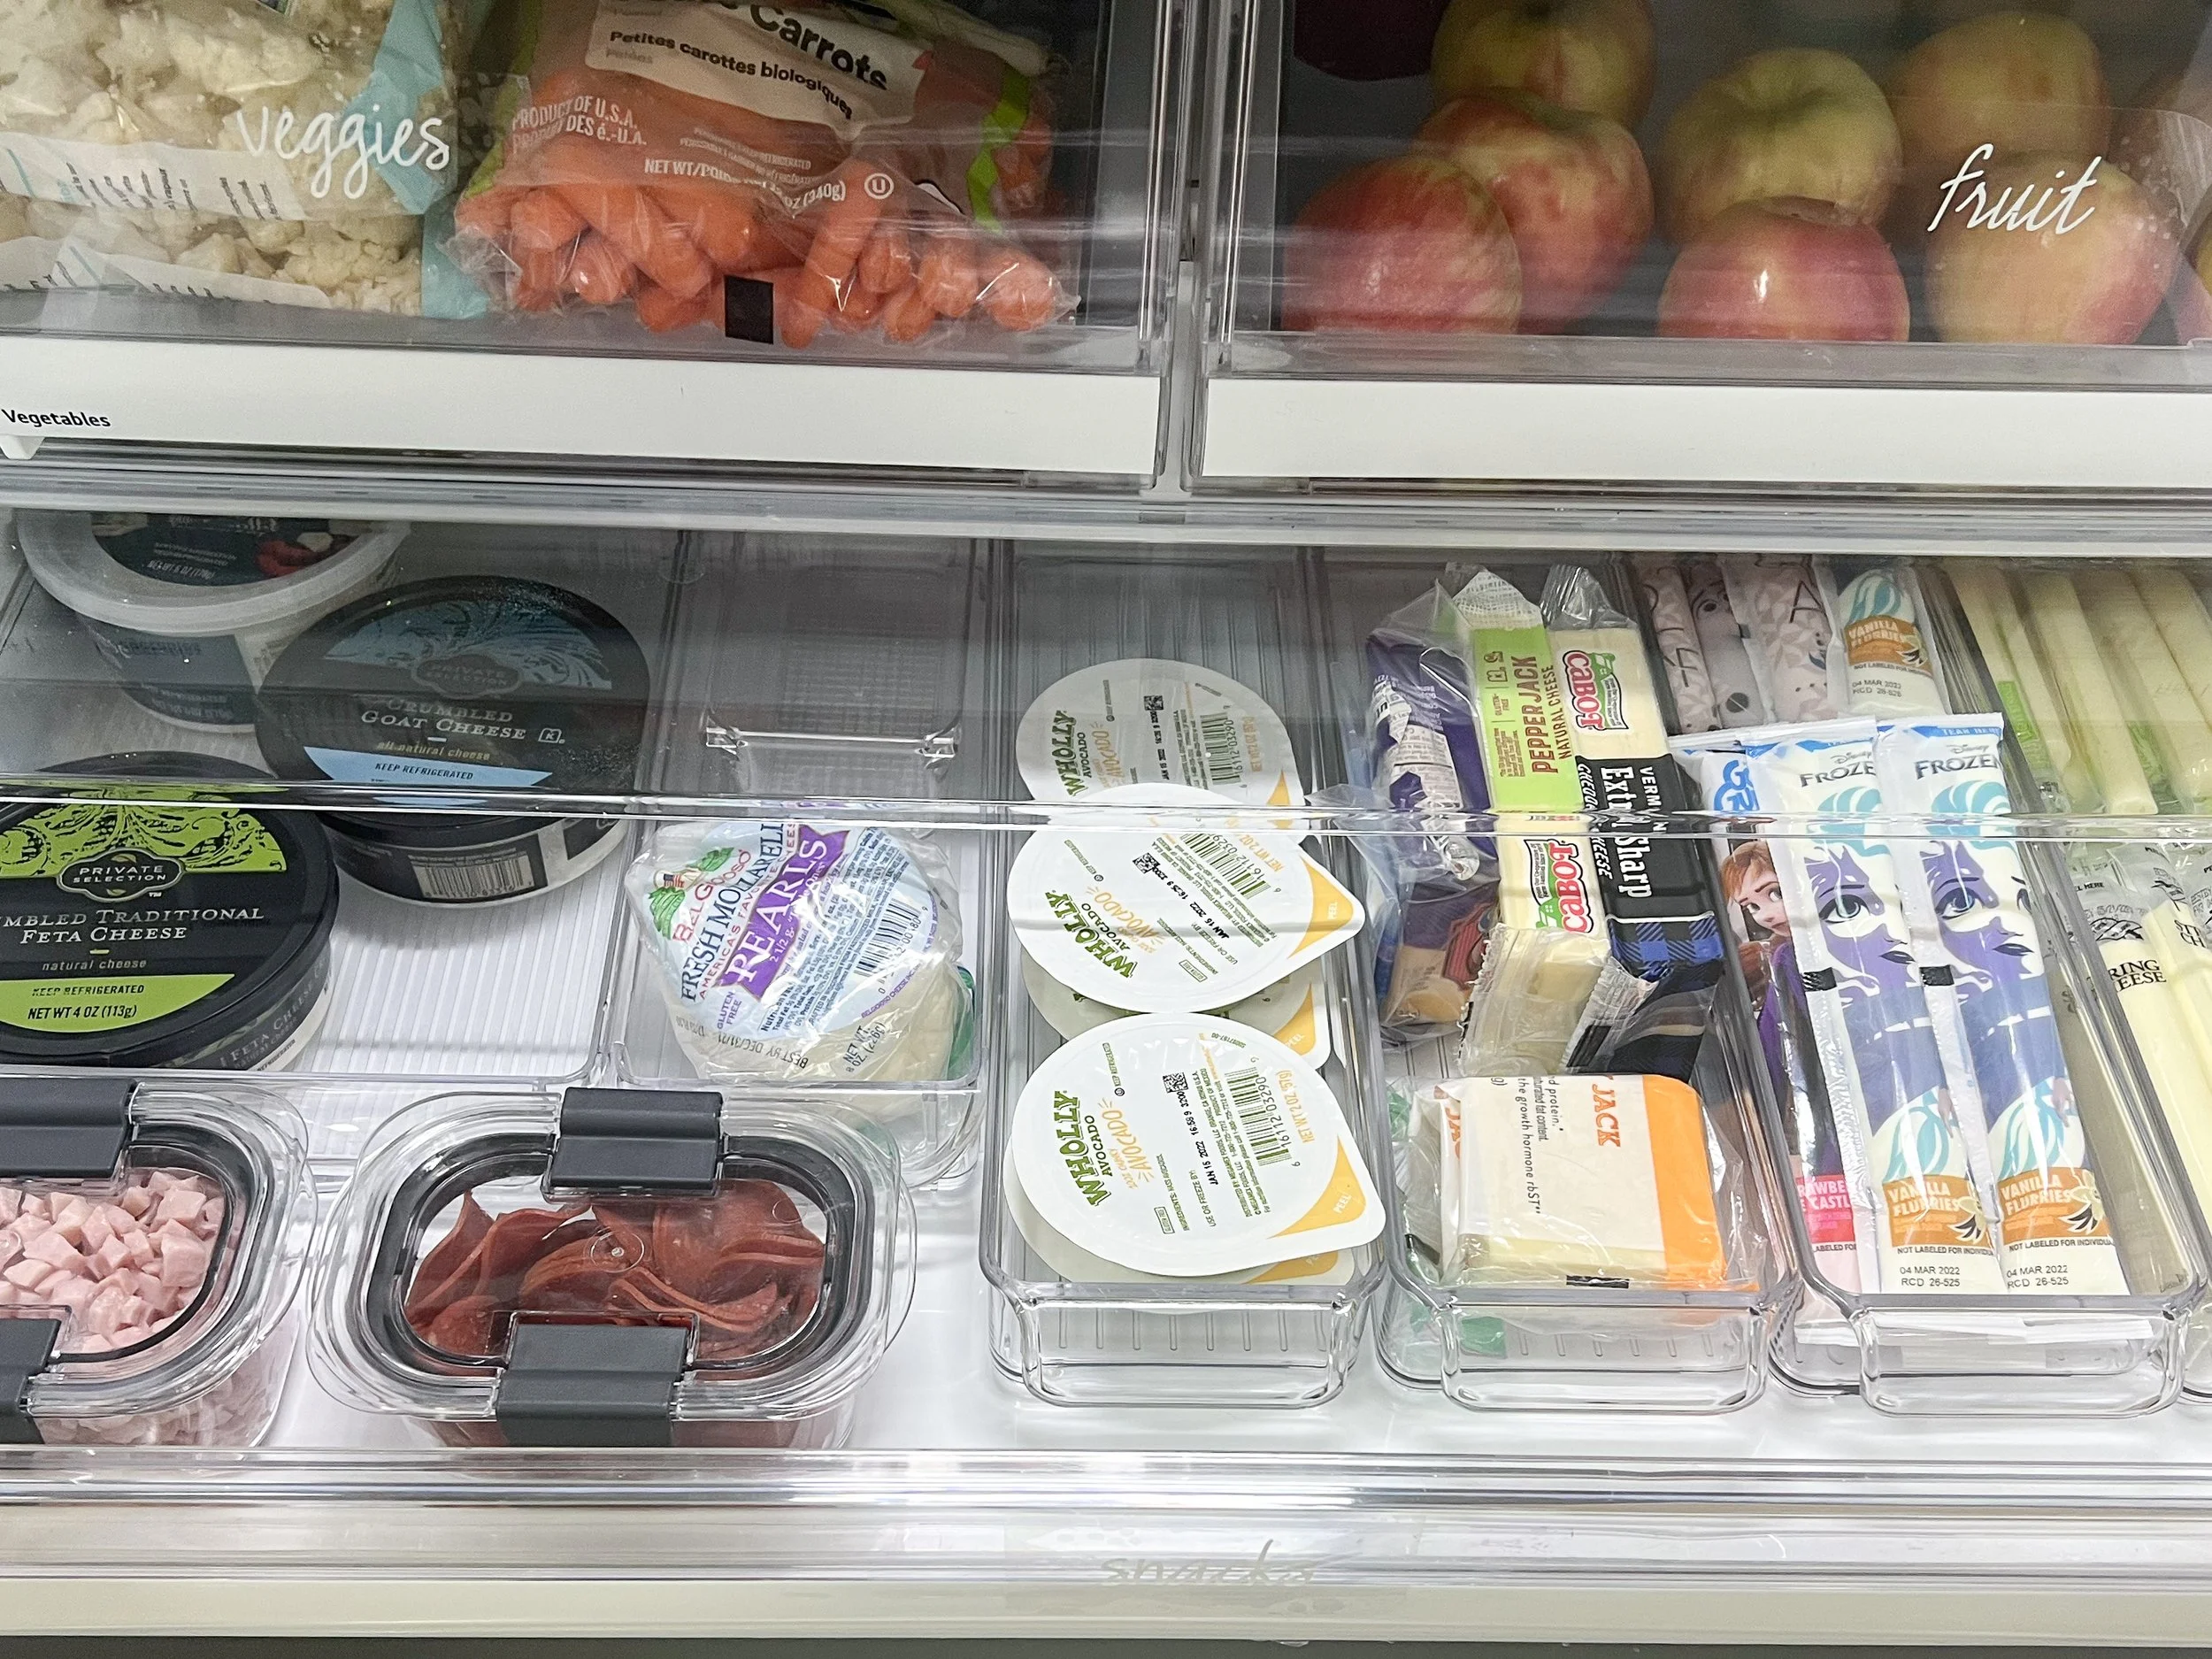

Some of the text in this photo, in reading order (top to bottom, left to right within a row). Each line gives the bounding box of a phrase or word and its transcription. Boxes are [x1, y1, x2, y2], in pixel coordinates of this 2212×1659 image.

[610, 31, 675, 50] Petites
[679, 43, 757, 76] carottes
[749, 3, 887, 91] Carrots
[573, 95, 594, 113] OF
[565, 114, 595, 136] DES
[644, 158, 670, 174] NET
[1927, 143, 2106, 234] fruit
[1, 408, 111, 429] Vegetables
[1510, 656, 1559, 774] PEPPER JACK
[1541, 664, 1572, 760] NATURAL CHEESE
[361, 710, 527, 741] GOAT CHEESE
[1052, 710, 1088, 796] WHOLLY
[1077, 732, 1092, 778] AVOCADO
[1946, 743, 1990, 755] Disney
[402, 765, 474, 780] REFRIGERATED
[1800, 762, 1877, 787] FROZE
[73, 872, 167, 884] SELECTION
[79, 865, 165, 876] PRIVATE
[1237, 855, 1265, 880] 16112
[0, 906, 265, 928] MBLED TRADITIONAL
[726, 839, 827, 984] PEARLS
[1094, 892, 1160, 939] AVOCADO
[19, 926, 188, 945] FETA CHEESE
[1045, 890, 1138, 979] WHOLLY
[1081, 902, 1131, 951] AVOCADO
[1212, 926, 1230, 940] JAN
[1198, 927, 1220, 949] FREEZE
[42, 957, 147, 972] natural cheese
[680, 927, 725, 1002] FRESH
[699, 924, 742, 1001] AMERICA'S
[63, 984, 145, 996] REFRIGERATED
[27, 1004, 138, 1020] NET WT 4 OZ (113g)
[717, 991, 735, 1030] GLUTEN
[726, 998, 743, 1025] FREE
[842, 1042, 856, 1063] NET
[1176, 1090, 1190, 1108] 3200
[1255, 1076, 1278, 1112] 03290
[1592, 1083, 1621, 1148] JACK
[1271, 1114, 1293, 1149] 16112
[1515, 1078, 1534, 1179] the growth hormone
[1053, 1090, 1112, 1207] WHOLLY
[1084, 1115, 1113, 1177] AVOCADO
[1102, 1110, 1153, 1171] AVOCADO
[1194, 1141, 1210, 1158] 2022
[1202, 1160, 1212, 1171] 15
[1206, 1170, 1219, 1186] JAN
[2000, 1174, 2063, 1200] VANILA
[1192, 1179, 1207, 1204] FREEZE
[1886, 1182, 1952, 1202] VANLLA
[1202, 1203, 1212, 1215] OR
[1333, 1192, 1354, 1215] PEEL
[1204, 1213, 1217, 1228] USE
[2008, 1243, 2024, 1253] NOT
[2024, 1240, 2060, 1248] LABELED
[1914, 1266, 1936, 1275] MAR
[1939, 1266, 1961, 1275] 2022
[2006, 1264, 2069, 1279] 04 MAR 2022
[1929, 1278, 1961, 1287] 26-525
[2007, 1277, 2070, 1289] RCD 26-525
